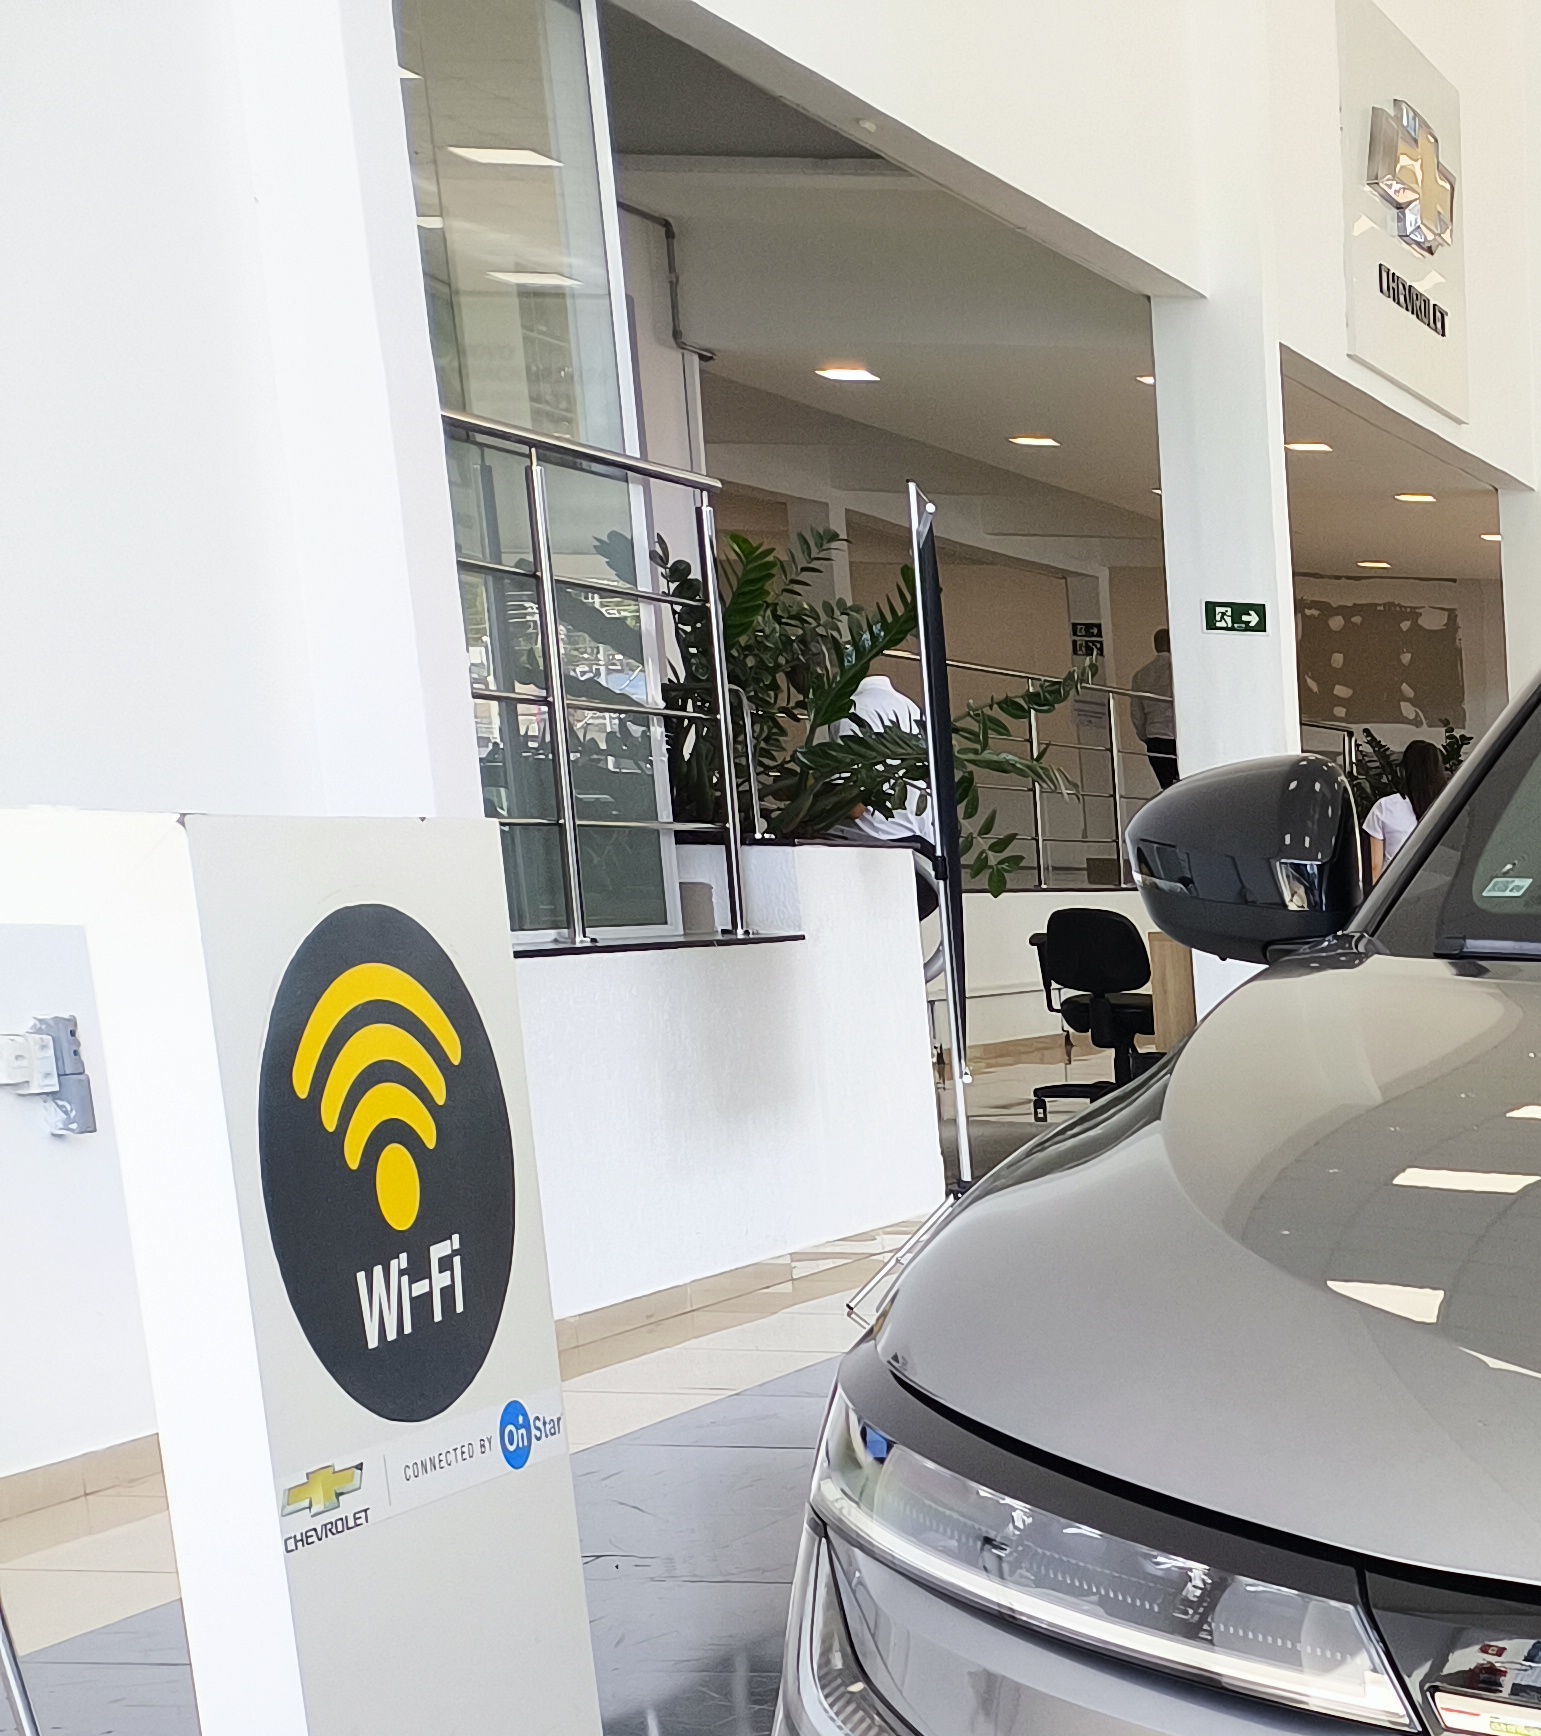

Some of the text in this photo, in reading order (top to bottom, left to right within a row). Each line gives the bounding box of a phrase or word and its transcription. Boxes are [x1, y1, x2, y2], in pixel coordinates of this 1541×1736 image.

[1378, 262, 1449, 338] CHEVROLET
[356, 1233, 464, 1350] Wi-Fi
[403, 1442, 475, 1482] CONNECTED
[479, 1435, 494, 1455] BY
[283, 1507, 371, 1554] CHEVROLET
